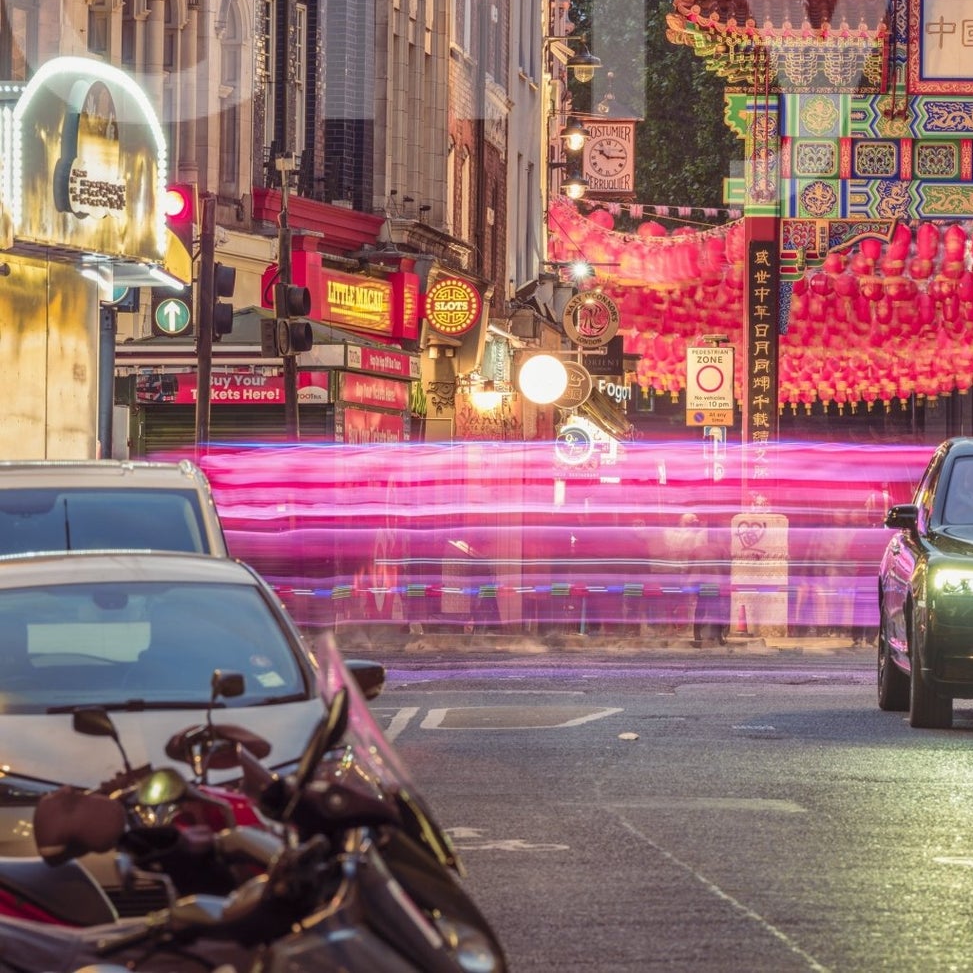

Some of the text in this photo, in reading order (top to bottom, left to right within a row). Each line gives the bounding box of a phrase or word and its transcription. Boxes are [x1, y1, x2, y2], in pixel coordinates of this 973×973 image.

[327, 280, 356, 307] LITTLE
[356, 286, 384, 313] MACAU
[434, 301, 469, 311] SLOTS
[565, 295, 582, 316] WAXY
[576, 336, 602, 345] LONDON
[697, 356, 723, 364] ZONE
[234, 375, 266, 386] Your
[190, 388, 280, 400] Tkets Here!
